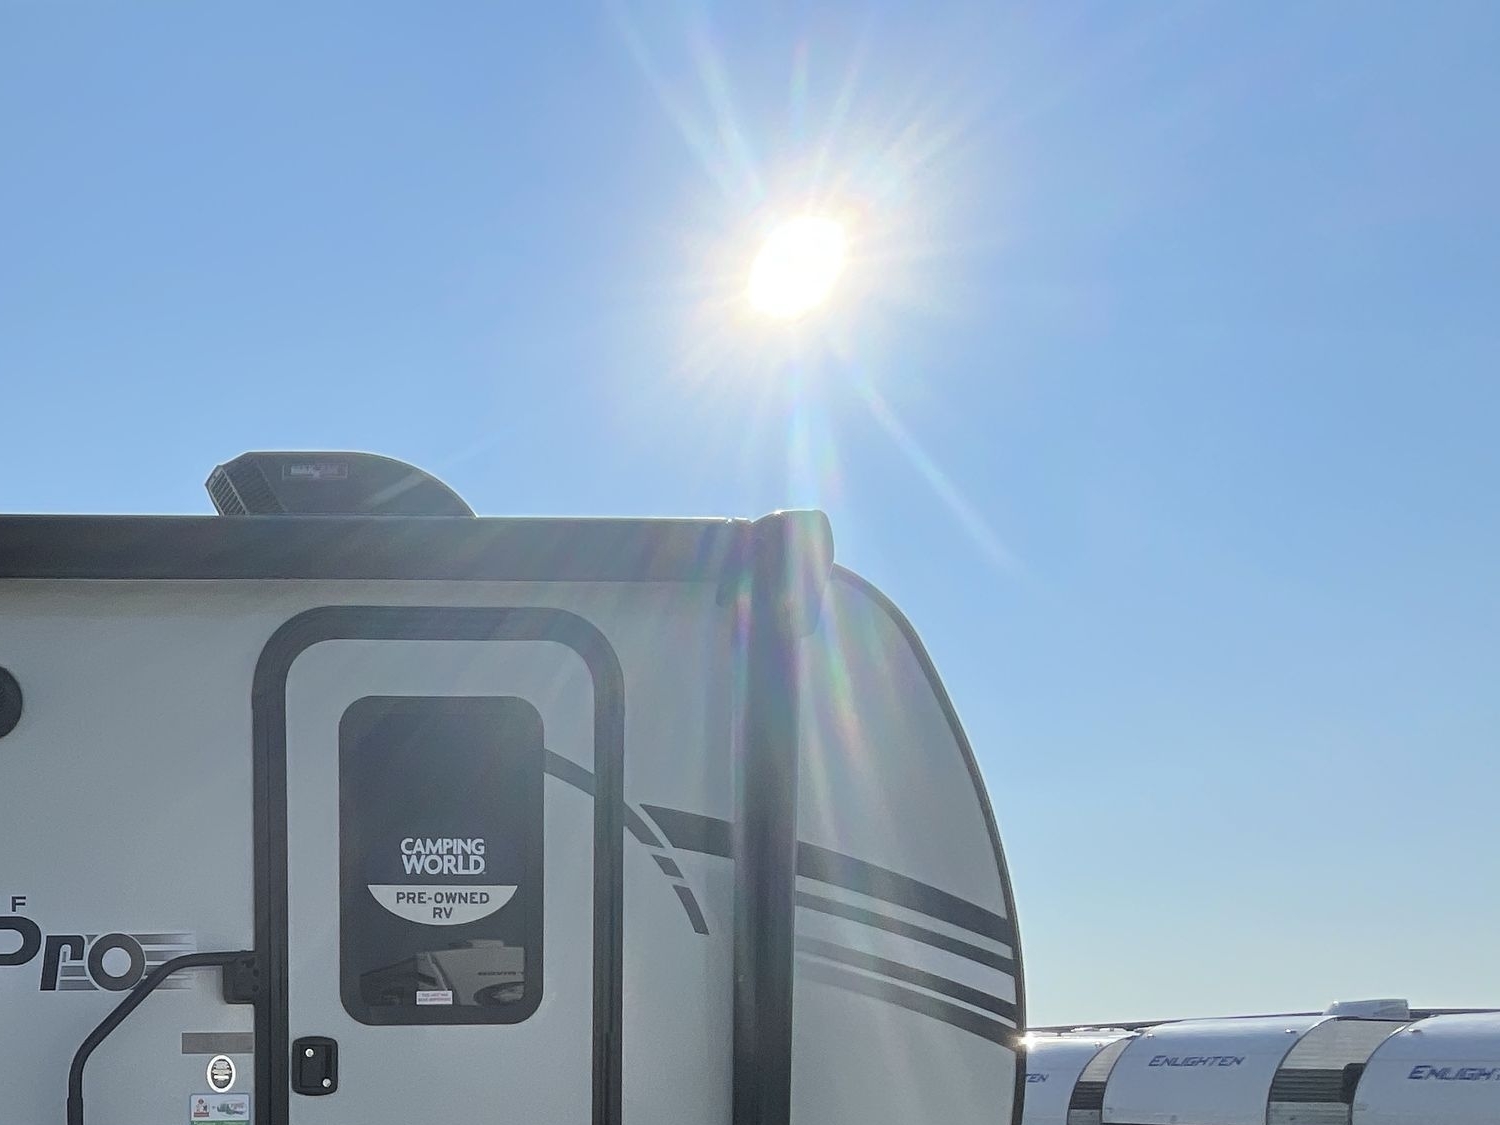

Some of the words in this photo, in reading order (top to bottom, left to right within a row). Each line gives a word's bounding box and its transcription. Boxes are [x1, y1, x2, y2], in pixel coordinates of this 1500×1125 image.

[400, 838, 485, 855] CAMPING
[401, 855, 486, 875] WORLD
[396, 892, 490, 904] PRE-OWNED
[432, 907, 453, 919] RV
